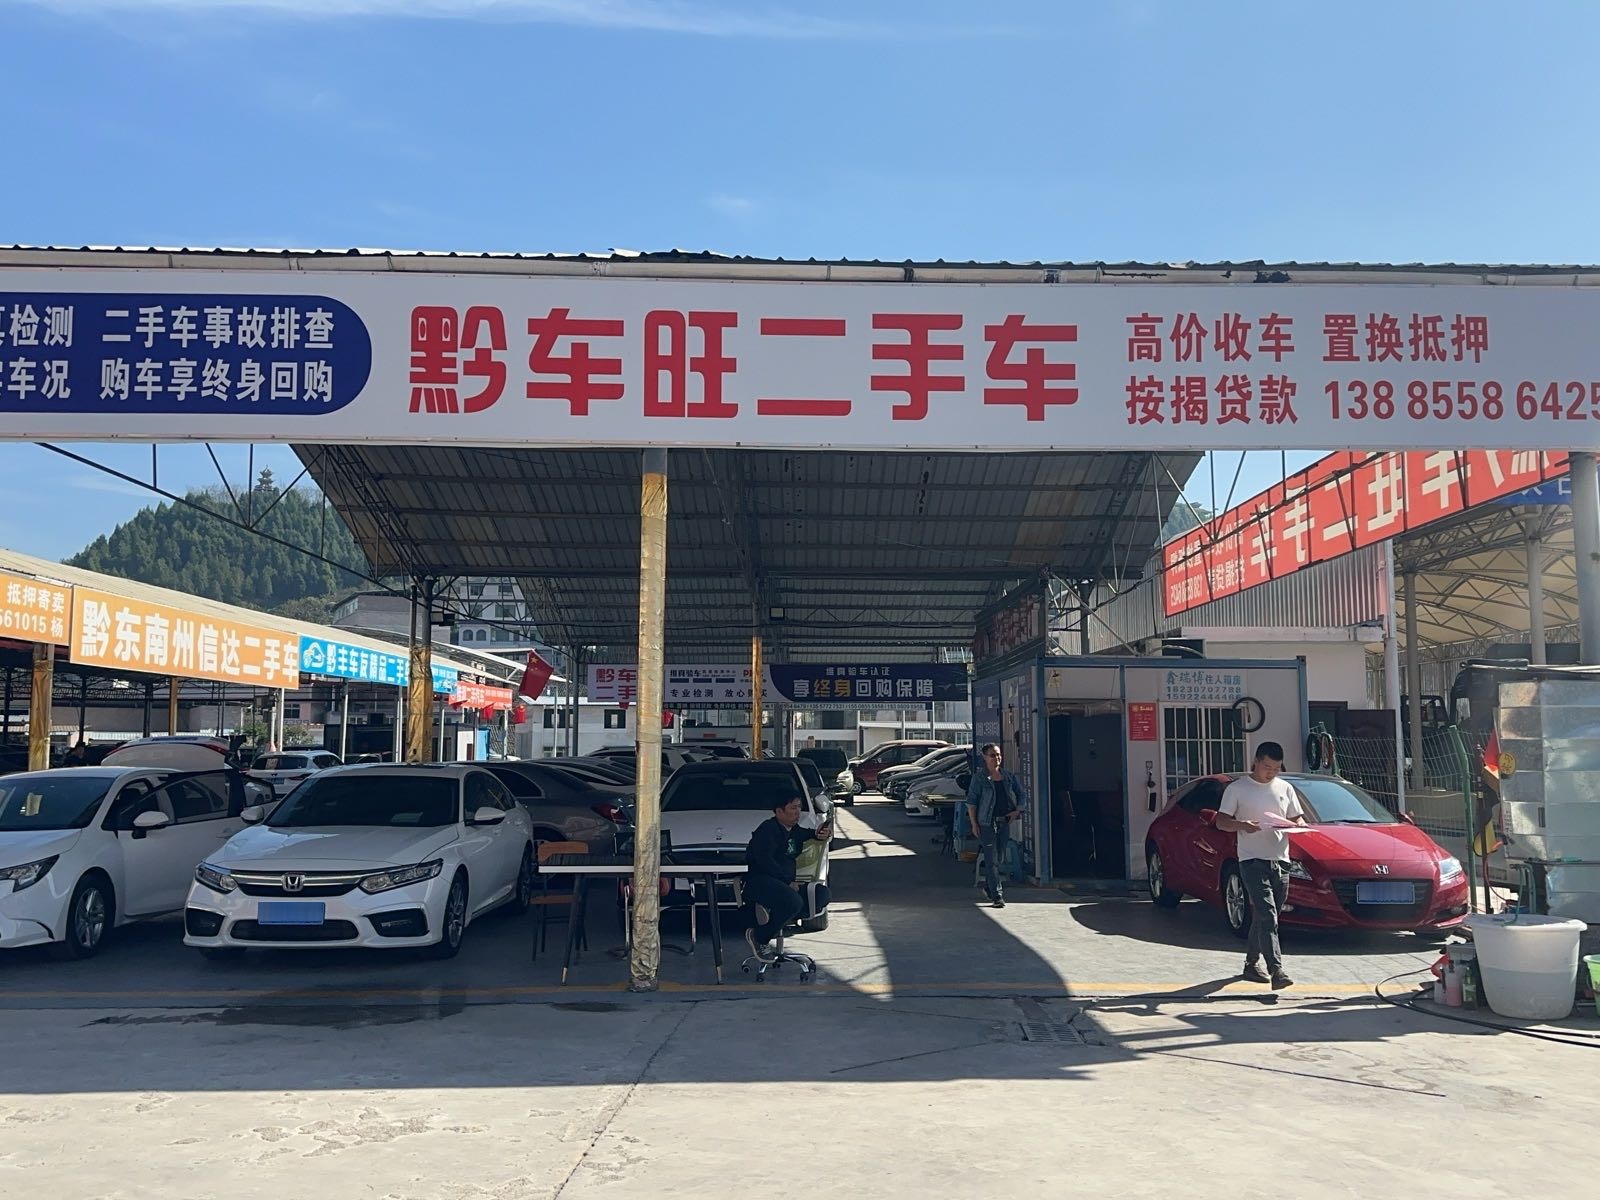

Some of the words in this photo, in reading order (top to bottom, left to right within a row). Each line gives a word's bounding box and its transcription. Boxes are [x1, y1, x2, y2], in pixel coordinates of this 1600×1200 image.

[0, 304, 75, 349] 检测
[102, 305, 335, 350] 二手车事故排查
[1125, 312, 1295, 363] 高价收车
[1322, 313, 1490, 364] 置换抵押
[0, 357, 71, 400] 车况
[100, 358, 333, 402] 购车享终身回购
[408, 305, 1080, 422] 黔车旺二手车
[1125, 374, 1299, 426] 按揭贷款
[1324, 381, 1395, 420] 138
[1407, 381, 1503, 420] 8558
[7, 582, 65, 614] 抵押寄卖
[50, 615, 64, 639] 杨
[80, 599, 300, 683] 黔东南州信达二手车
[670, 688, 714, 698] 专业检测
[793, 678, 934, 697] 享终身回购保障
